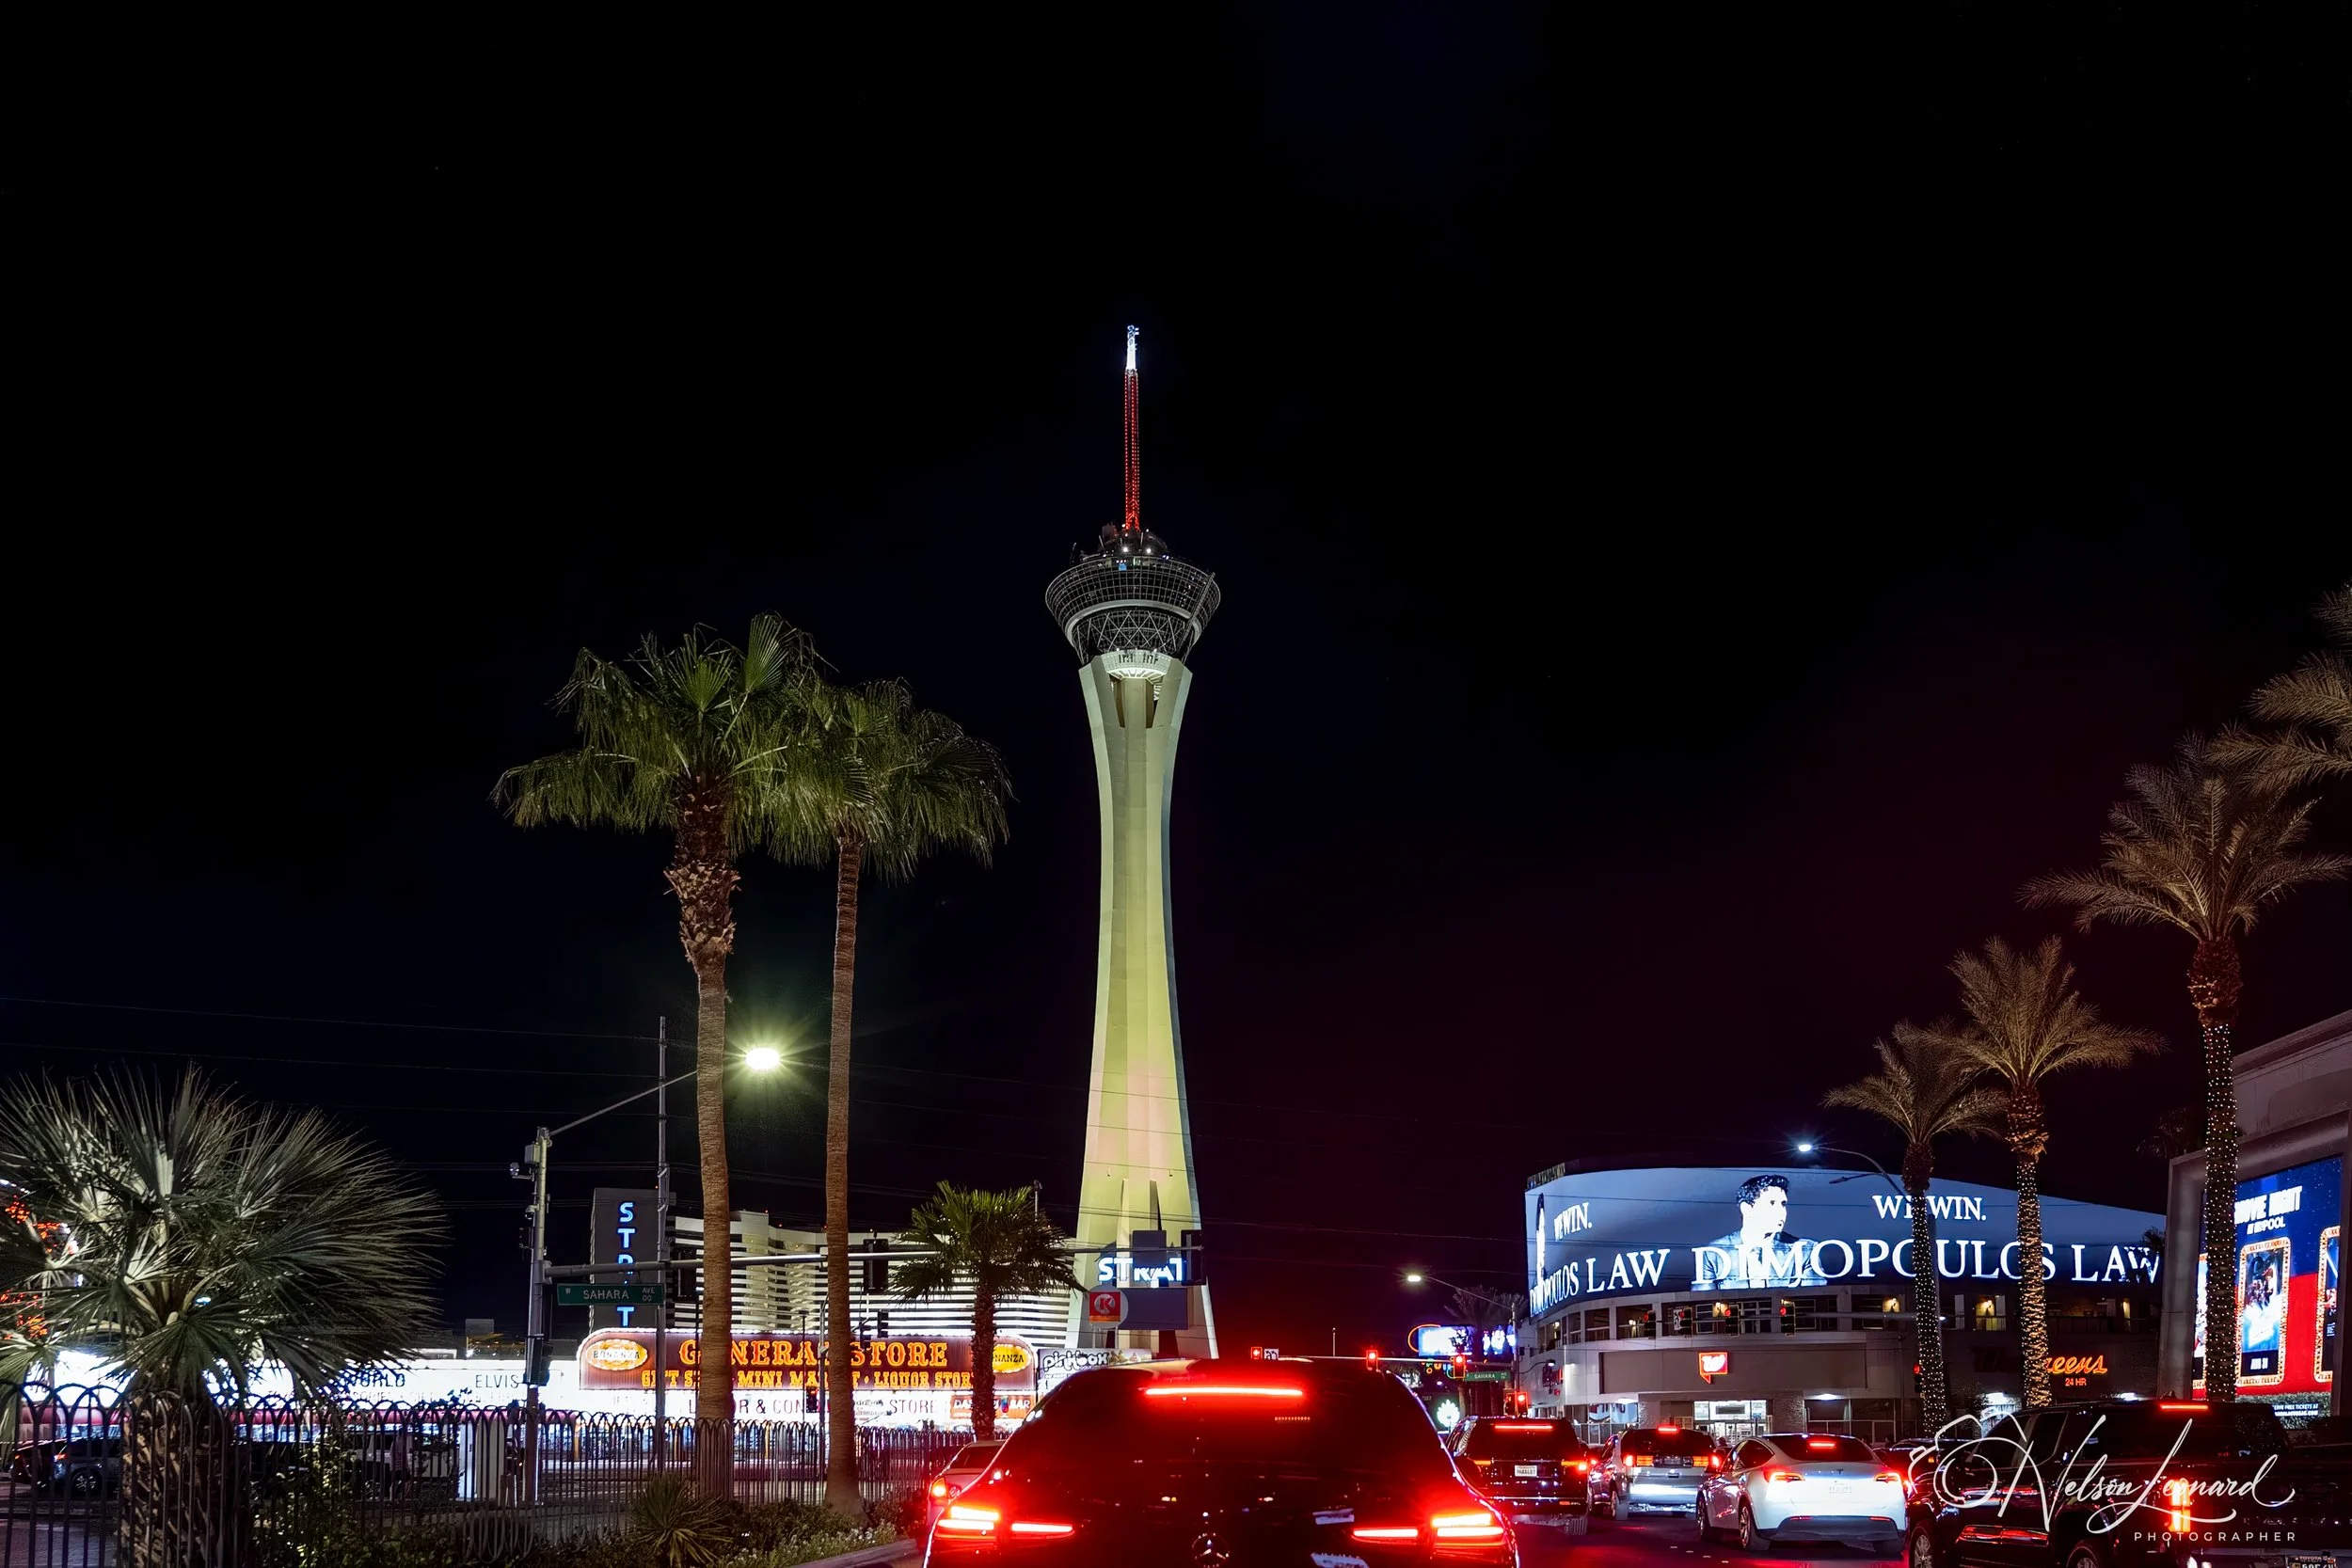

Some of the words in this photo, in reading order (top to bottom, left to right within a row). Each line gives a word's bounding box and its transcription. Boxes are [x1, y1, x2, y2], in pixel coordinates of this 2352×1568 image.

[1927, 1196, 1987, 1221] WIN.
[1563, 1202, 1593, 1236] WIN.
[617, 1202, 636, 1326] STRT
[1586, 1248, 1671, 1293] LAW
[583, 1290, 629, 1300] SAHARA
[994, 1354, 1025, 1363] NANZA
[475, 1374, 519, 1388] ELVIS
[737, 1370, 783, 1387] MINI
[874, 1371, 930, 1389] LIQUOR
[934, 1371, 975, 1388] STOR
[2075, 1378, 2087, 1386] HR
[1009, 1400, 1030, 1410] BAR
